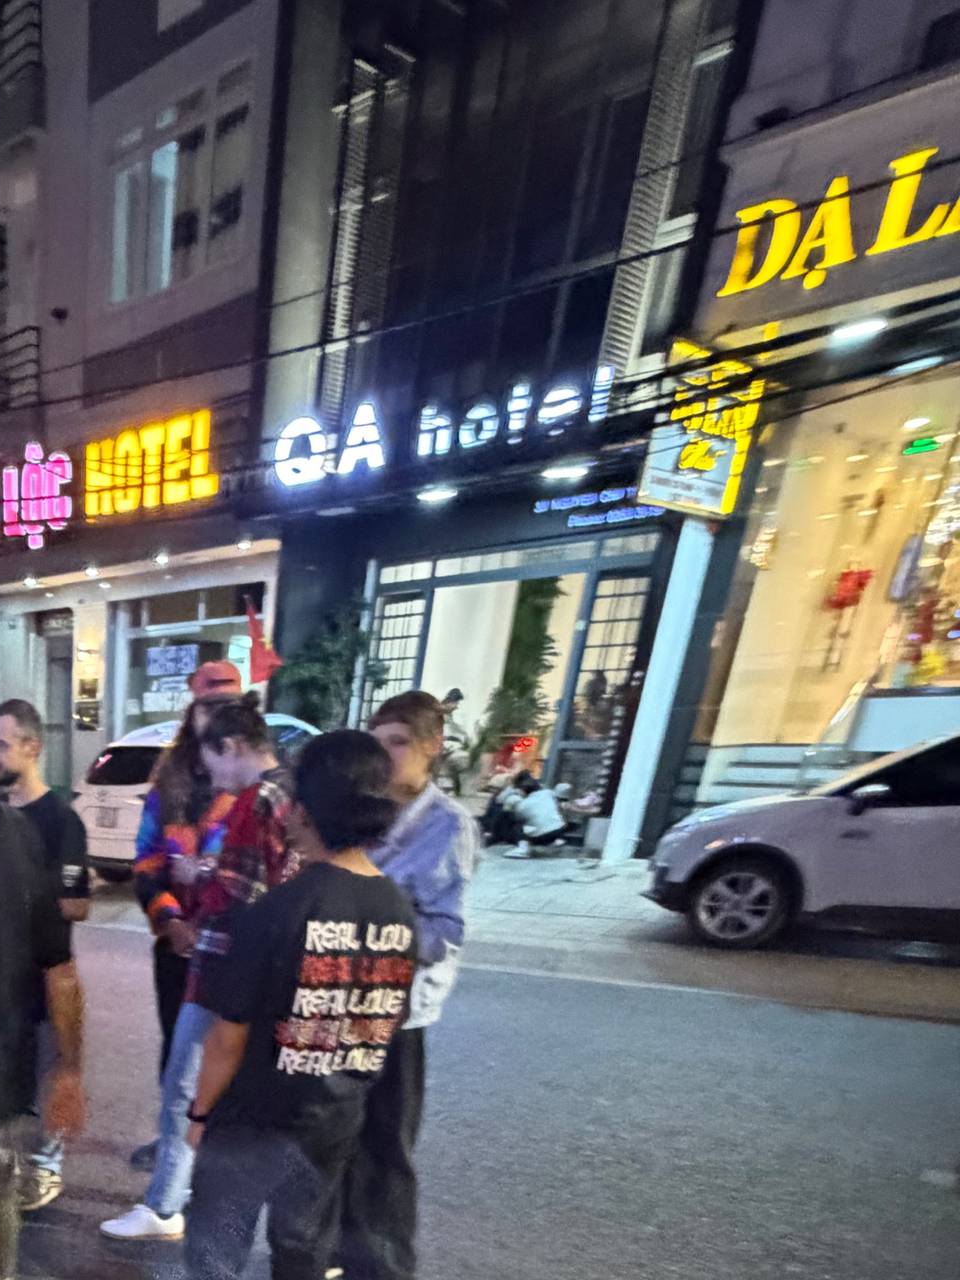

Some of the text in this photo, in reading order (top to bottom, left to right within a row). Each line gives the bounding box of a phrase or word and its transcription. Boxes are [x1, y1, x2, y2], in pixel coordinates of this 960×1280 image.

[716, 175, 857, 297] DẠ
[84, 408, 220, 523] HOTEL
[305, 920, 360, 953] REAL
